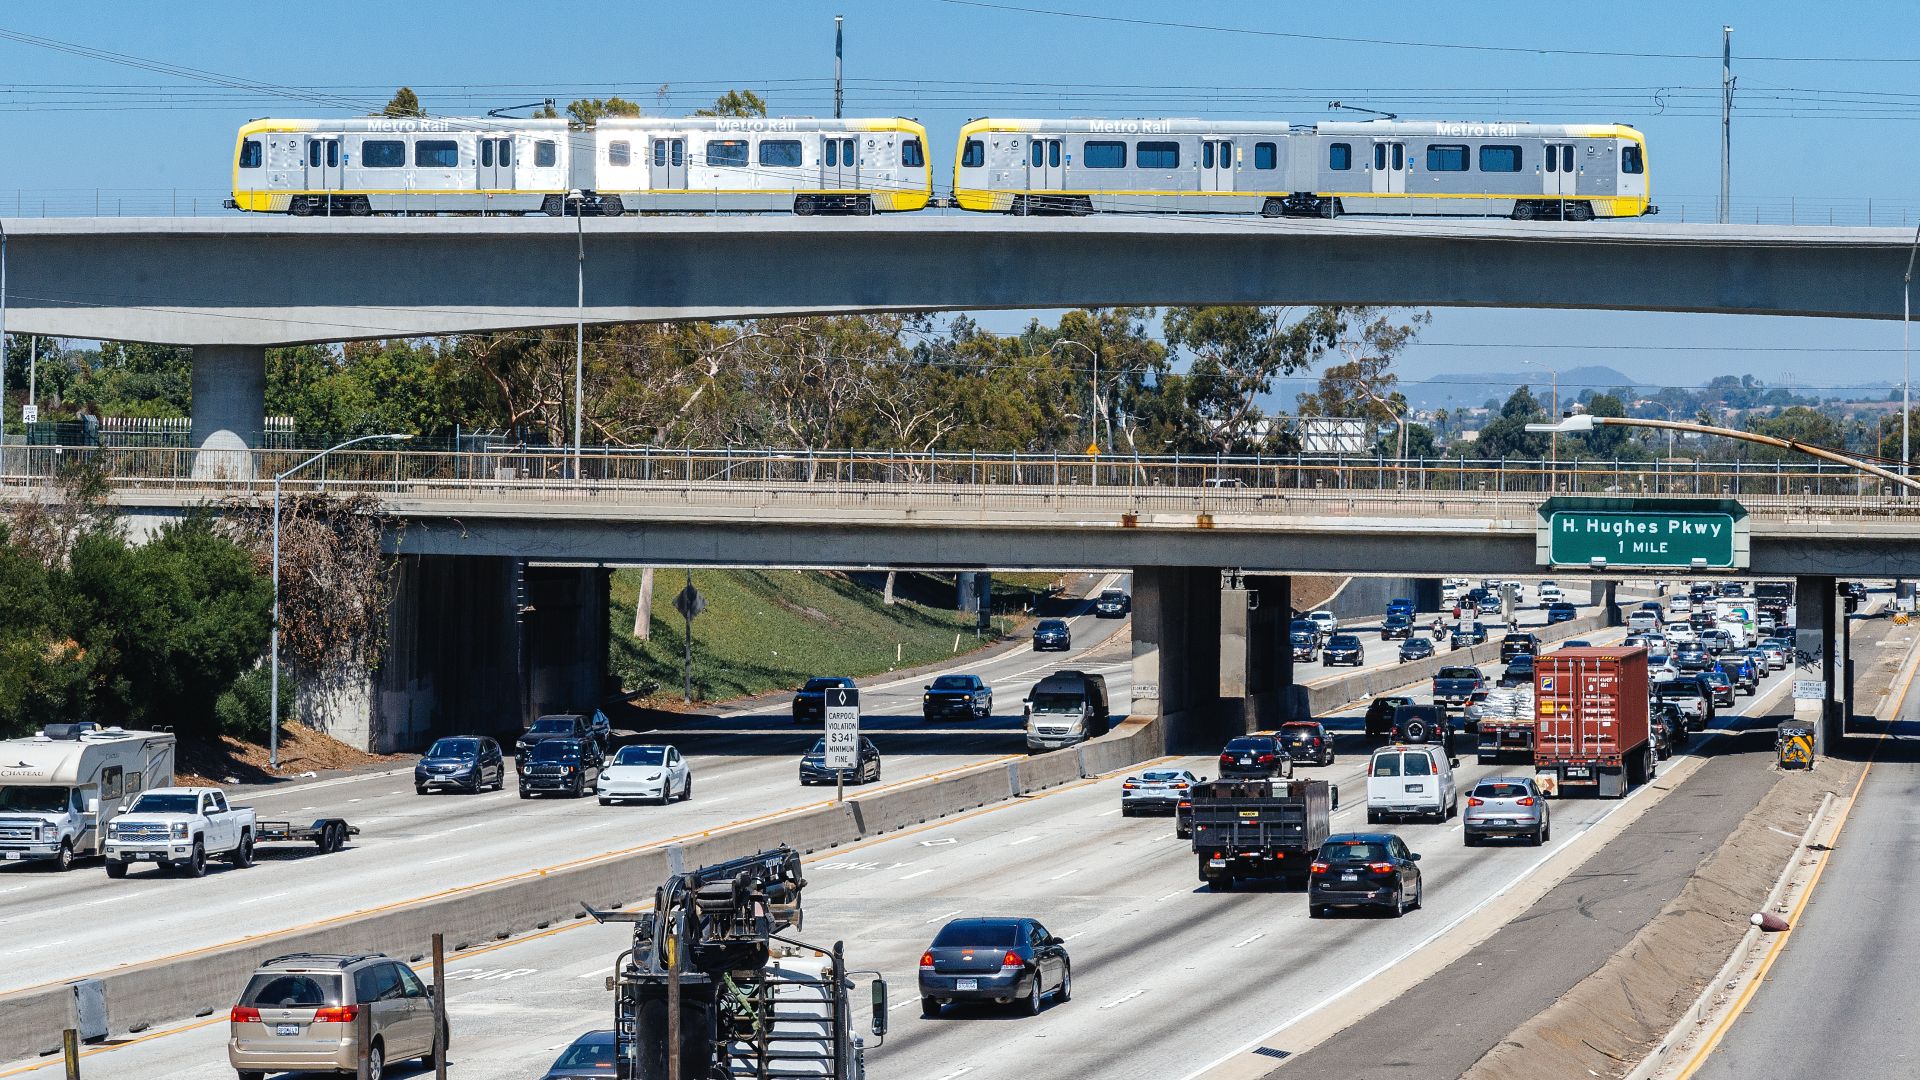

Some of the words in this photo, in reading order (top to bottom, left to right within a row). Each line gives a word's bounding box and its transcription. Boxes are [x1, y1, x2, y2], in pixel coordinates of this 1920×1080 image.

[367, 120, 415, 132] Metro
[420, 120, 449, 132] Rail
[715, 120, 763, 132] Metro
[768, 120, 796, 132] Rail
[1089, 120, 1138, 133] Metro
[1142, 120, 1170, 133] Rail
[1436, 123, 1485, 136] Metro
[1488, 123, 1517, 136] Rail
[1563, 518, 1579, 533] H.
[1587, 518, 1658, 537] Hughes
[1668, 520, 1722, 538] Pkwy
[1618, 541, 1624, 554] 1
[1633, 542, 1668, 553] MILE
[829, 712, 856, 720] CARPOOL
[828, 722, 857, 731] VIOLATION
[831, 732, 853, 743] $341
[829, 745, 855, 753] MINIMUM
